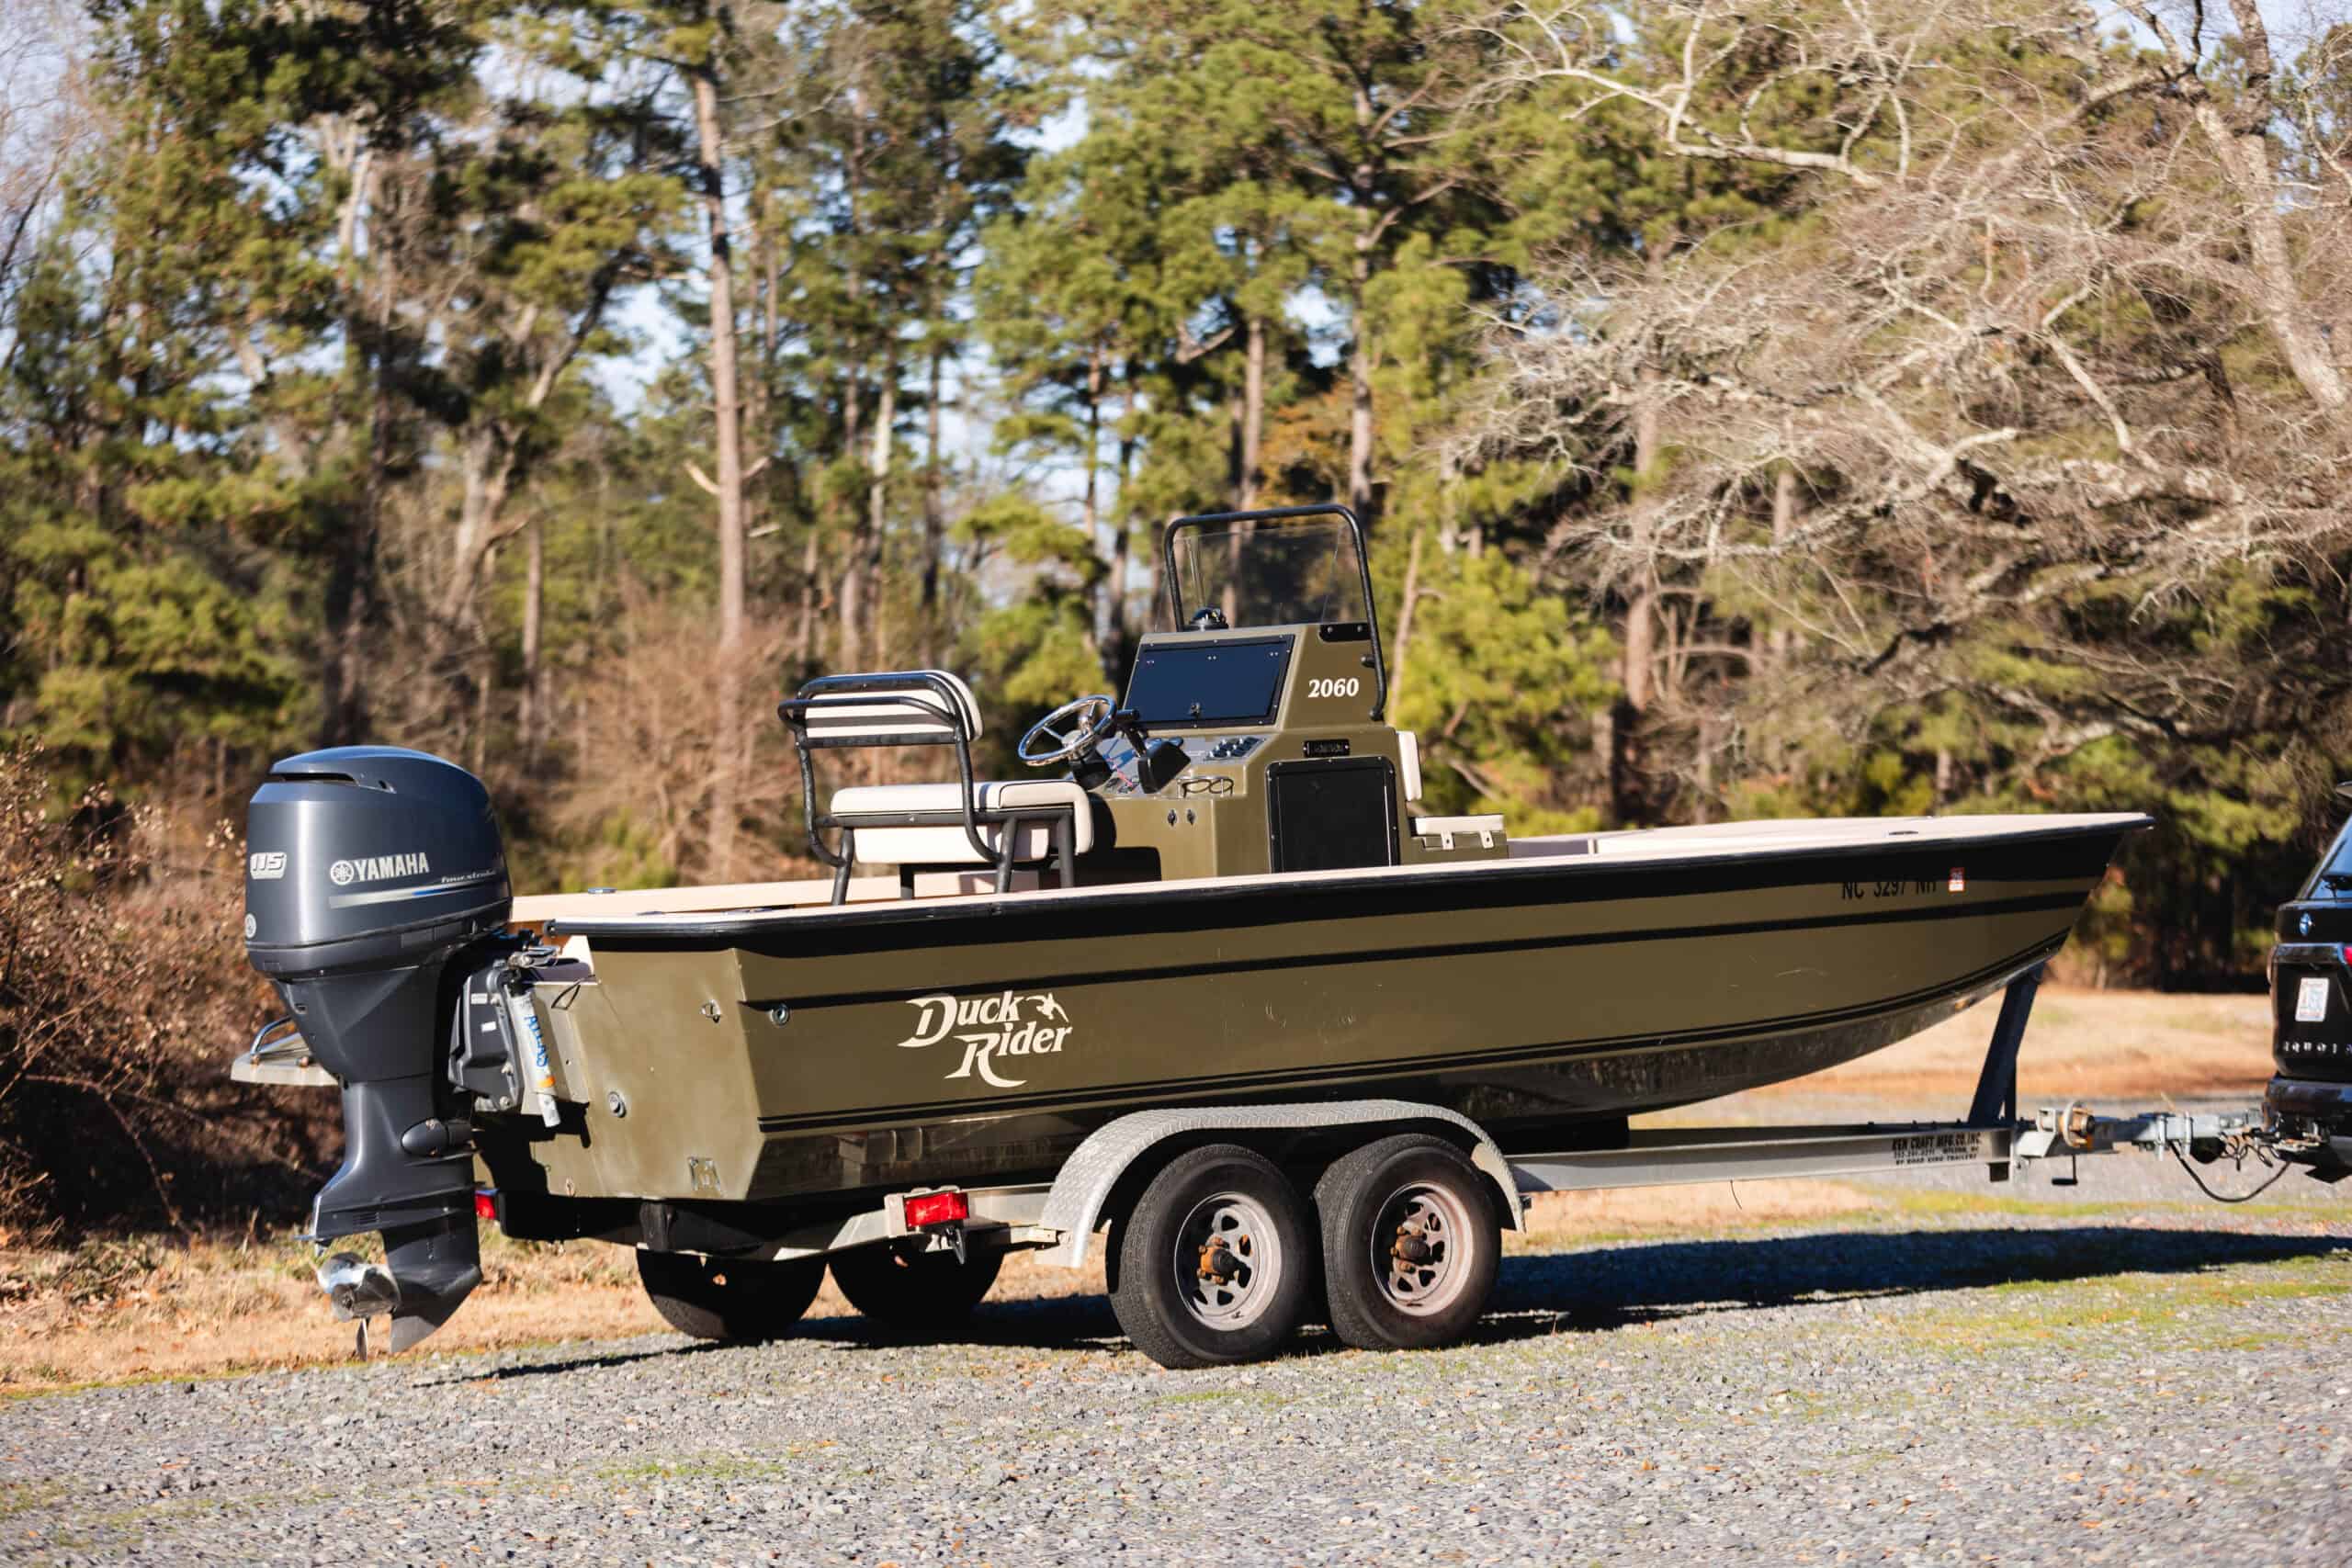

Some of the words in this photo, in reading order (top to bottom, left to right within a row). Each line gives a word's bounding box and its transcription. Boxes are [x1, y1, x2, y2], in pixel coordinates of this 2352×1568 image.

[1308, 678, 1360, 698] 2060
[355, 852, 430, 883] YAMAHA
[1842, 881, 1865, 899] NC
[897, 990, 1025, 1048] Duck
[944, 1021, 1074, 1088] Rider
